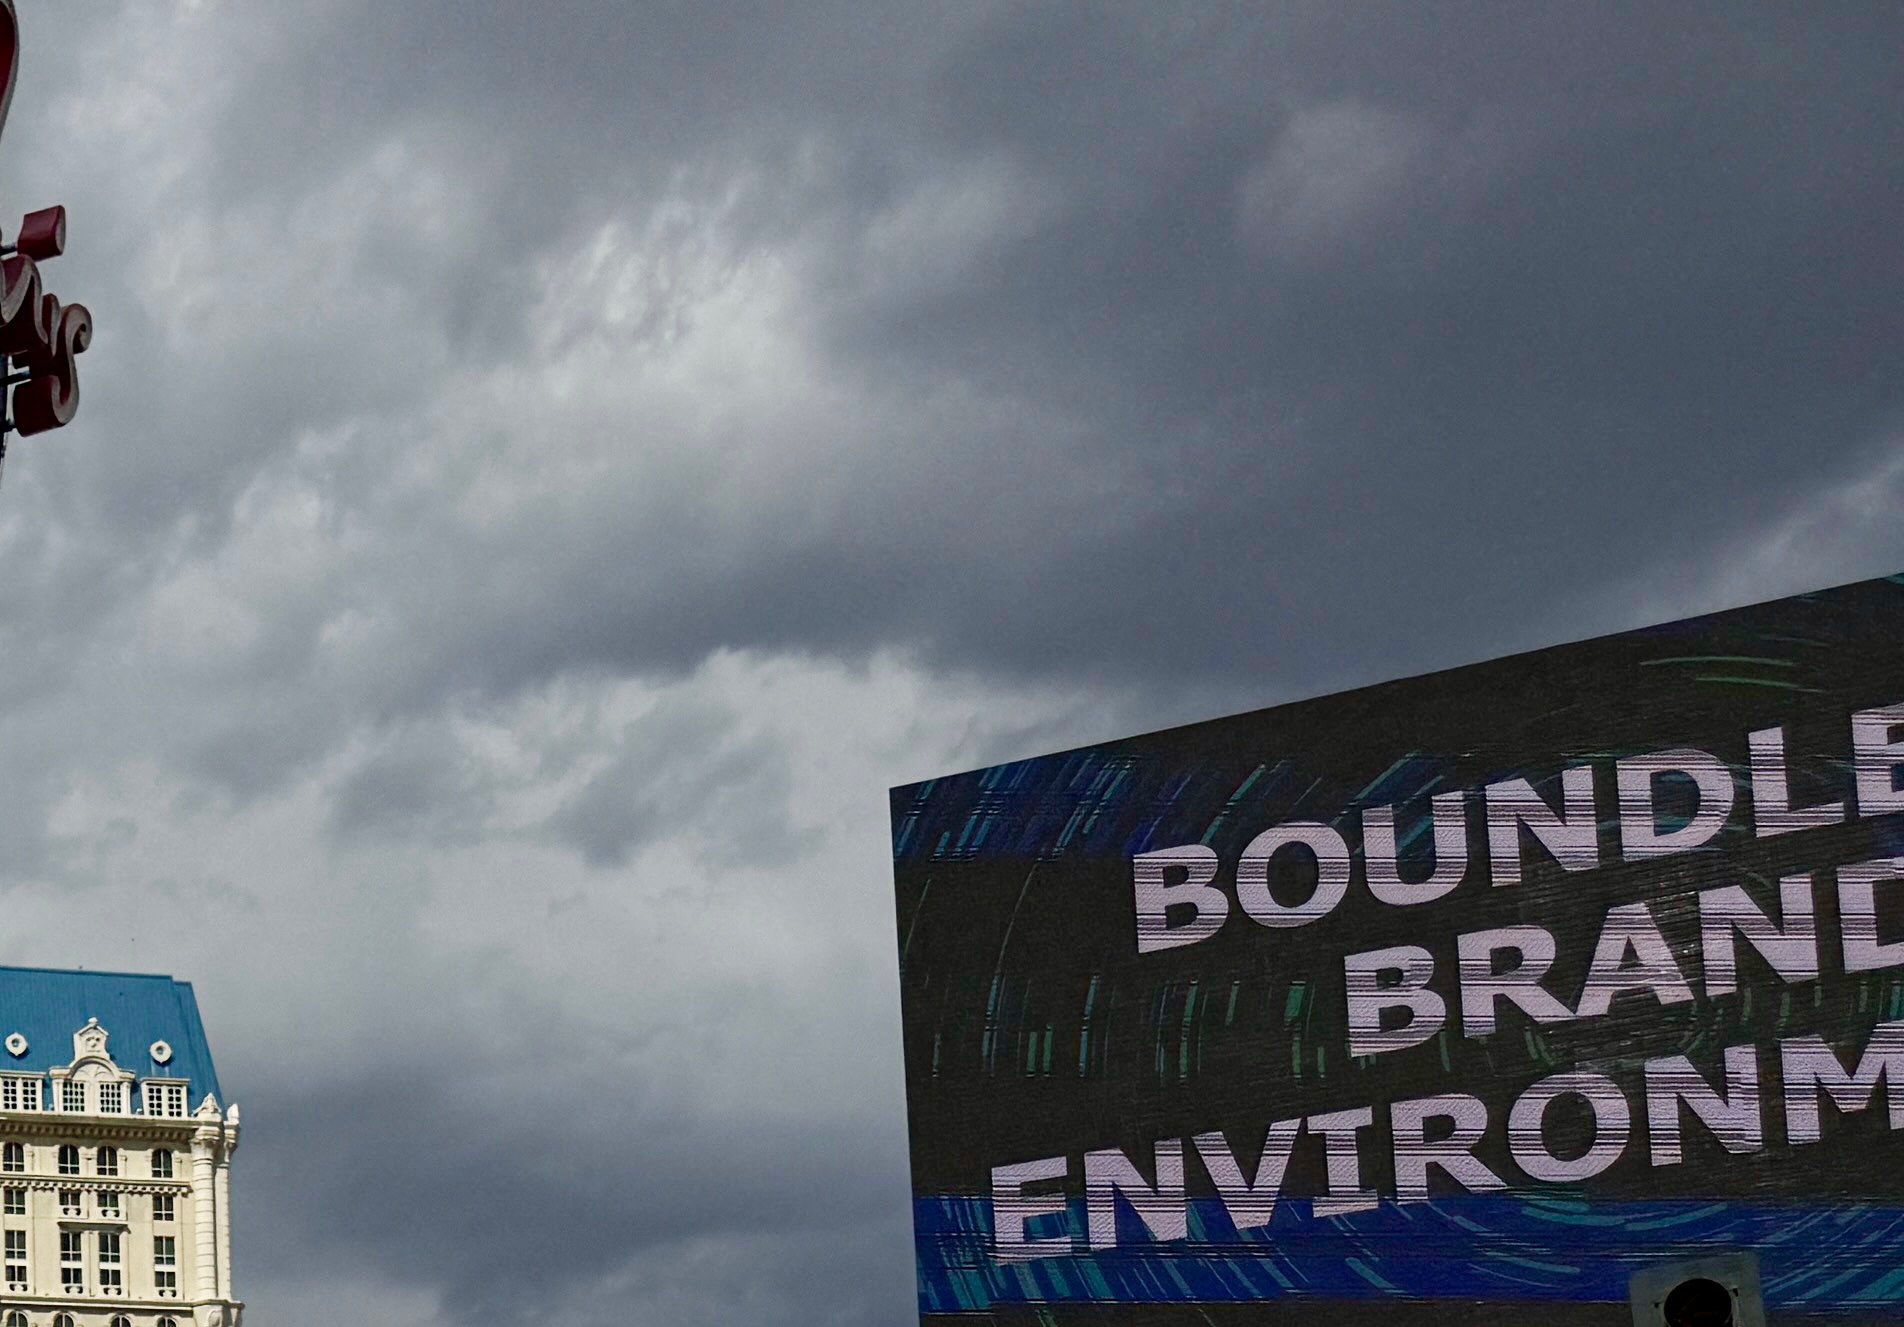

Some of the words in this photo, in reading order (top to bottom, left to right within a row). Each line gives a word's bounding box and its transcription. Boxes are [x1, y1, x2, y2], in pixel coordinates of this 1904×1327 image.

[1132, 703, 1904, 955] BOUNDLE
[1344, 856, 1904, 1057] BRAND
[992, 1018, 1904, 1265] ENVIRONM
